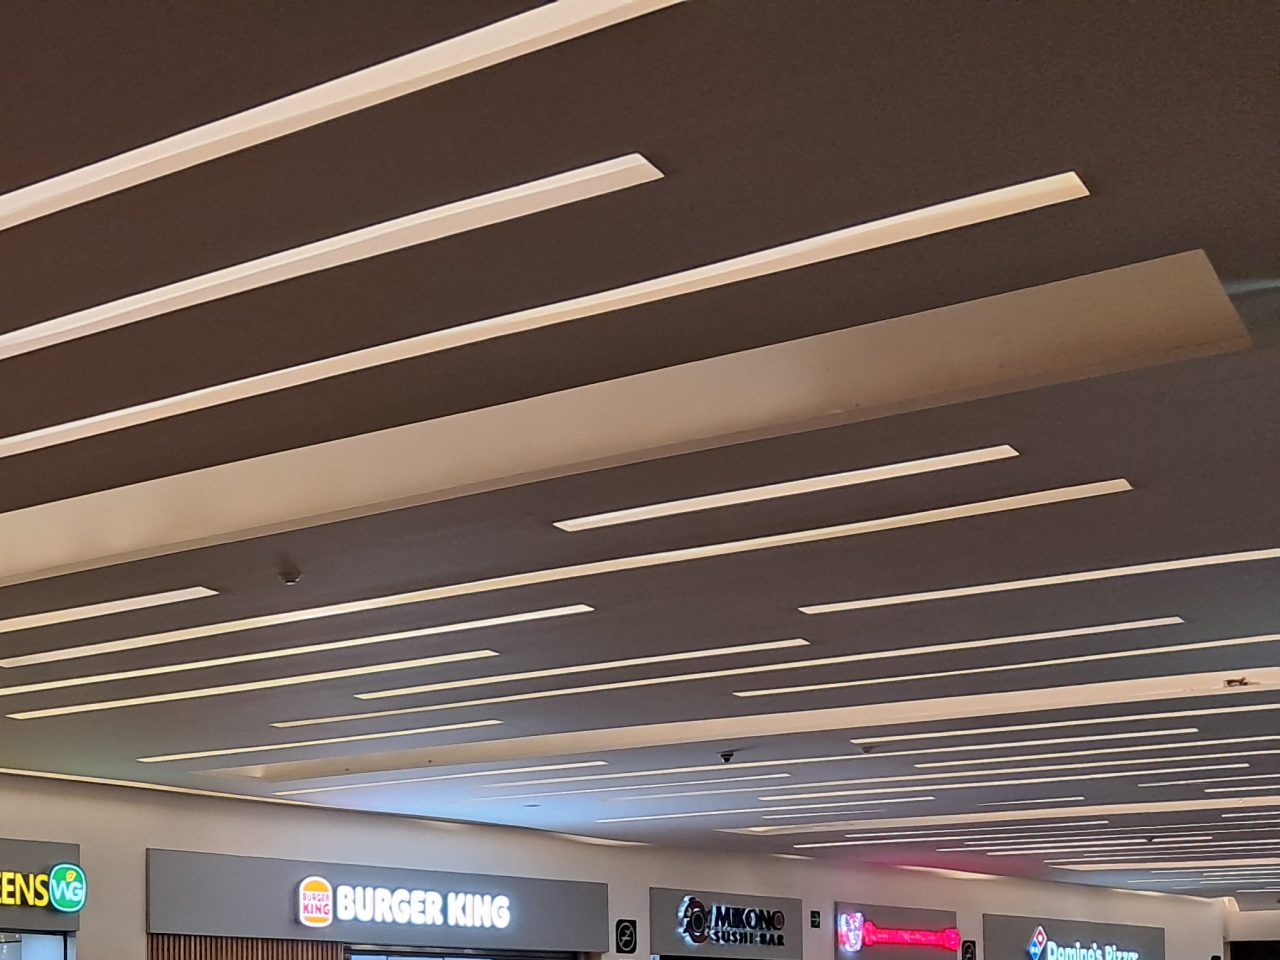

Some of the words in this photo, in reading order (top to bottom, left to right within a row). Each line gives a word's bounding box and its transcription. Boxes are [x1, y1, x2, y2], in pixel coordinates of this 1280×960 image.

[302, 892, 330, 902] BURGER
[302, 903, 331, 916] KING
[336, 885, 444, 926] BURGER
[447, 892, 511, 929] KING
